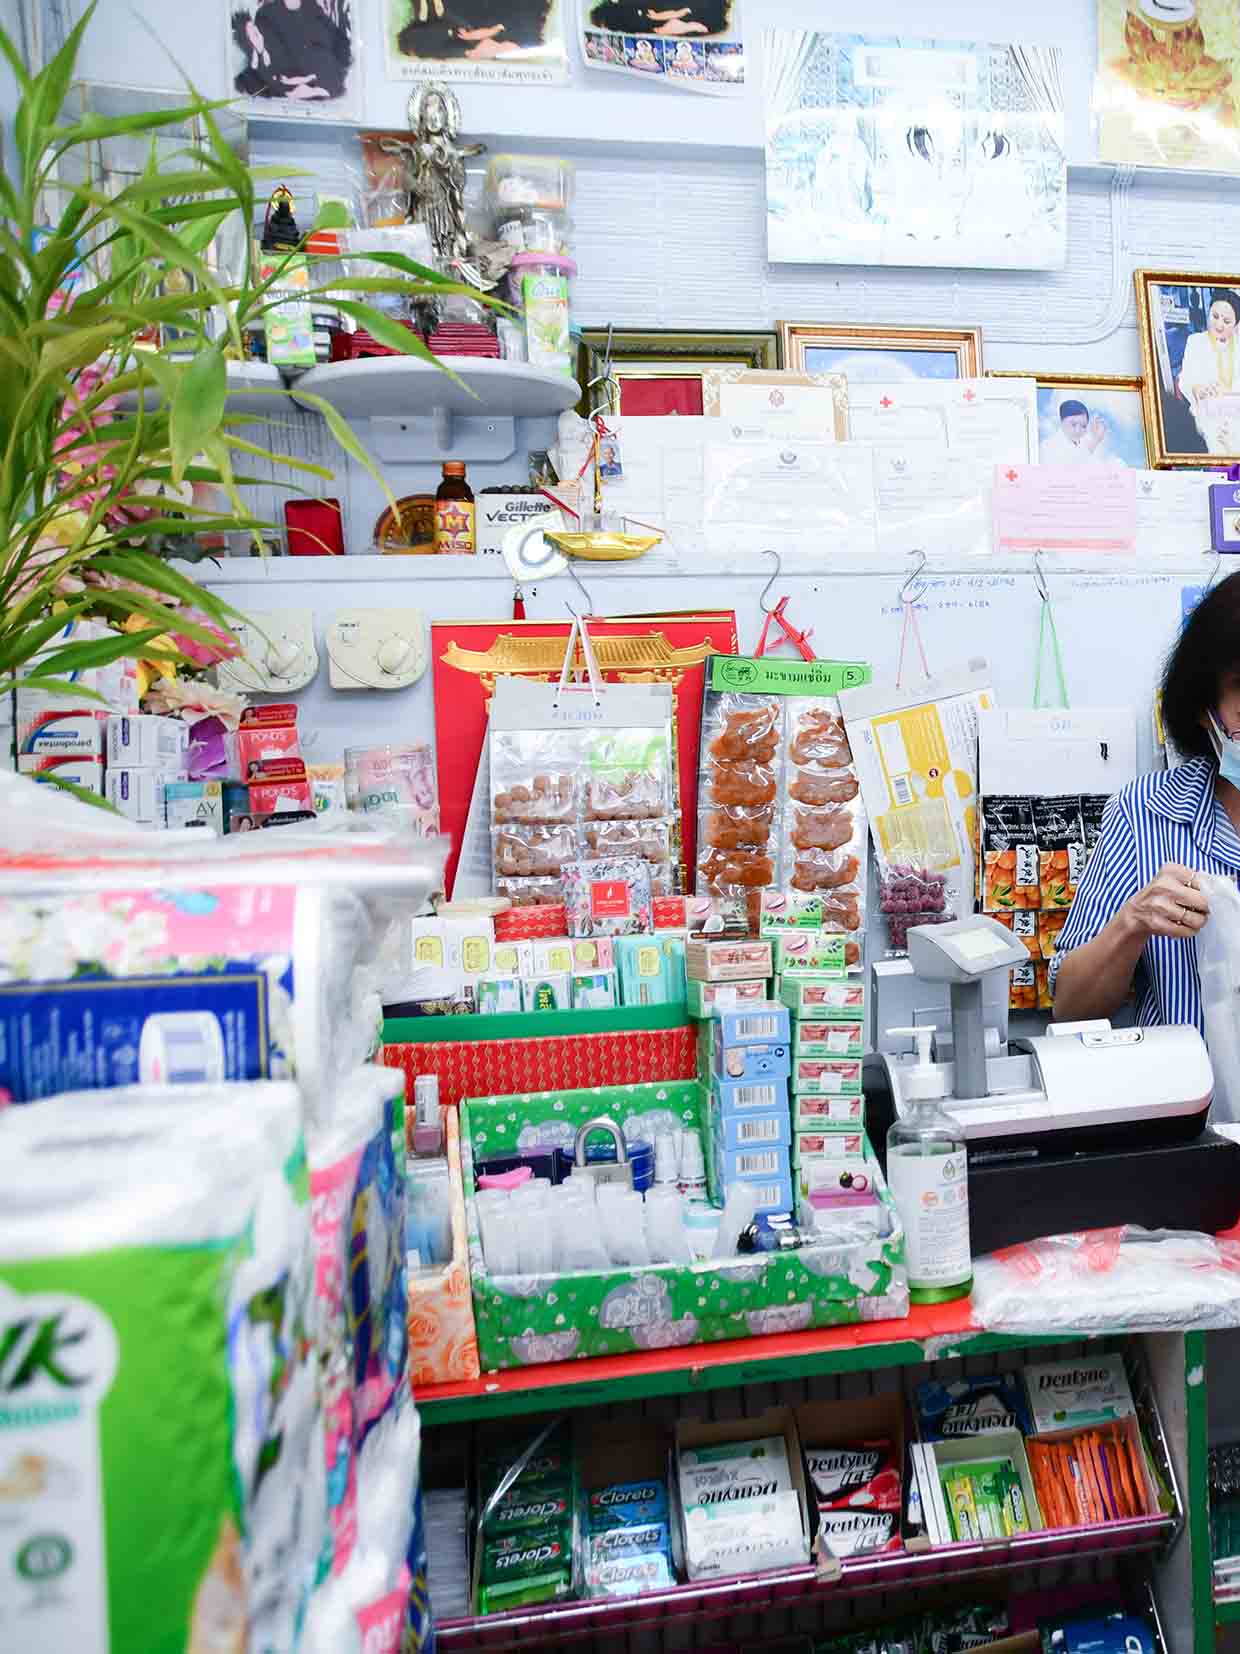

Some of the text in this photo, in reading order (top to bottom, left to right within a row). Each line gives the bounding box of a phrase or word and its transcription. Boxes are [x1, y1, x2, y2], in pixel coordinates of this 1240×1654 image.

[505, 501, 551, 513] Gillette
[486, 511, 536, 522] VECT
[1039, 1368, 1109, 1390] Dentyne
[807, 1451, 879, 1473] Dentyne
[841, 1470, 875, 1486] ICE
[599, 1487, 656, 1505] Clorets
[499, 1502, 560, 1521] Clorets
[823, 1513, 893, 1535] Dentyne
[601, 1529, 659, 1547] Clorets
[496, 1547, 557, 1569] Clorets
